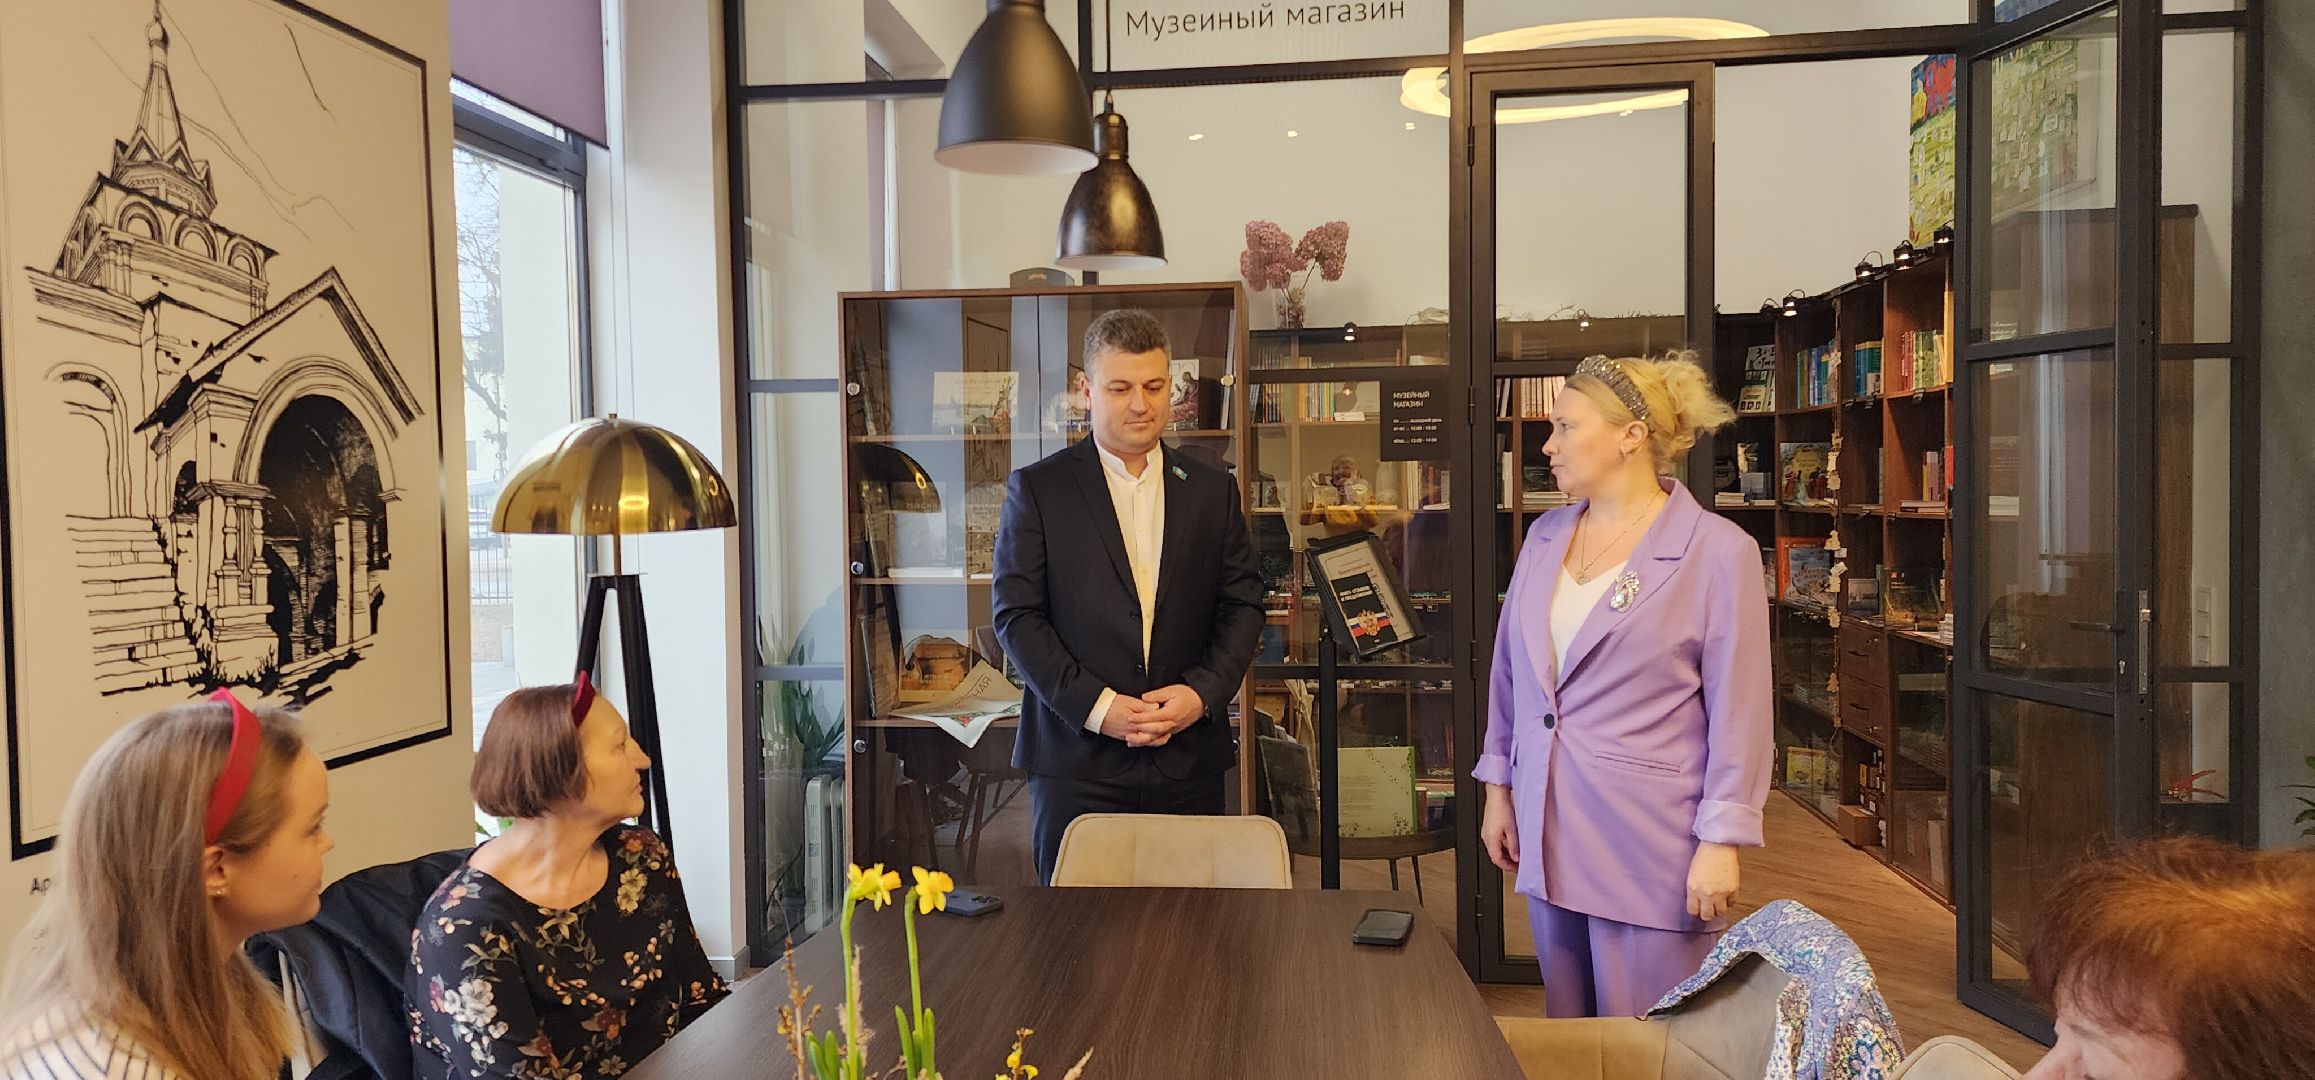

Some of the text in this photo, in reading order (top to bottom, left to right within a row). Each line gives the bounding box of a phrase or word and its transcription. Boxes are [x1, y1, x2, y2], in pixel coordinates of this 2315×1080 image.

[1286, 1, 1405, 26] магазин
[1393, 390, 1431, 400] МУЗЕЙНЫЙ
[1393, 400, 1425, 409] МАГАЗИН
